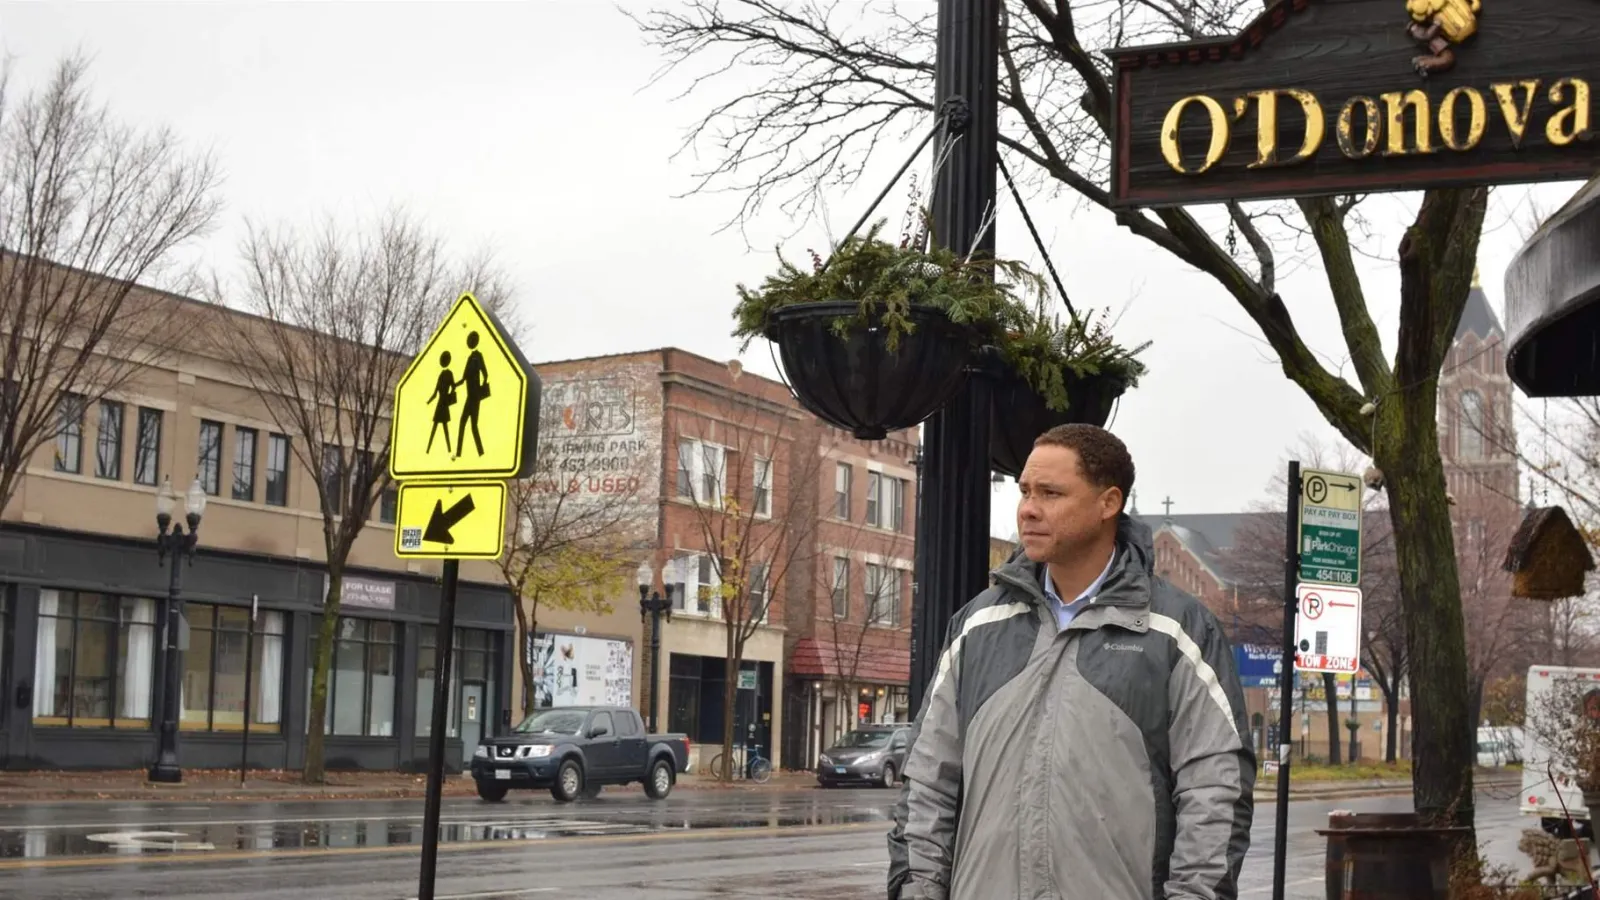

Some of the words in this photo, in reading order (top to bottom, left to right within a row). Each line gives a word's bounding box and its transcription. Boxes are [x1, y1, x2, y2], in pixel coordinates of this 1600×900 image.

[610, 440, 647, 453] PARK
[588, 477, 641, 493] USED
[1304, 507, 1317, 516] PAY
[1318, 509, 1327, 517] AT
[1328, 510, 1341, 519] PAY
[1342, 512, 1357, 521] BOX
[1312, 540, 1357, 556] ParkChicago
[345, 582, 363, 590] FOR
[365, 584, 392, 595] LEASE
[1110, 643, 1144, 653] Columbia
[1300, 655, 1322, 668] TOW
[1325, 656, 1354, 671] ZONE
[1259, 677, 1276, 685] ATM
